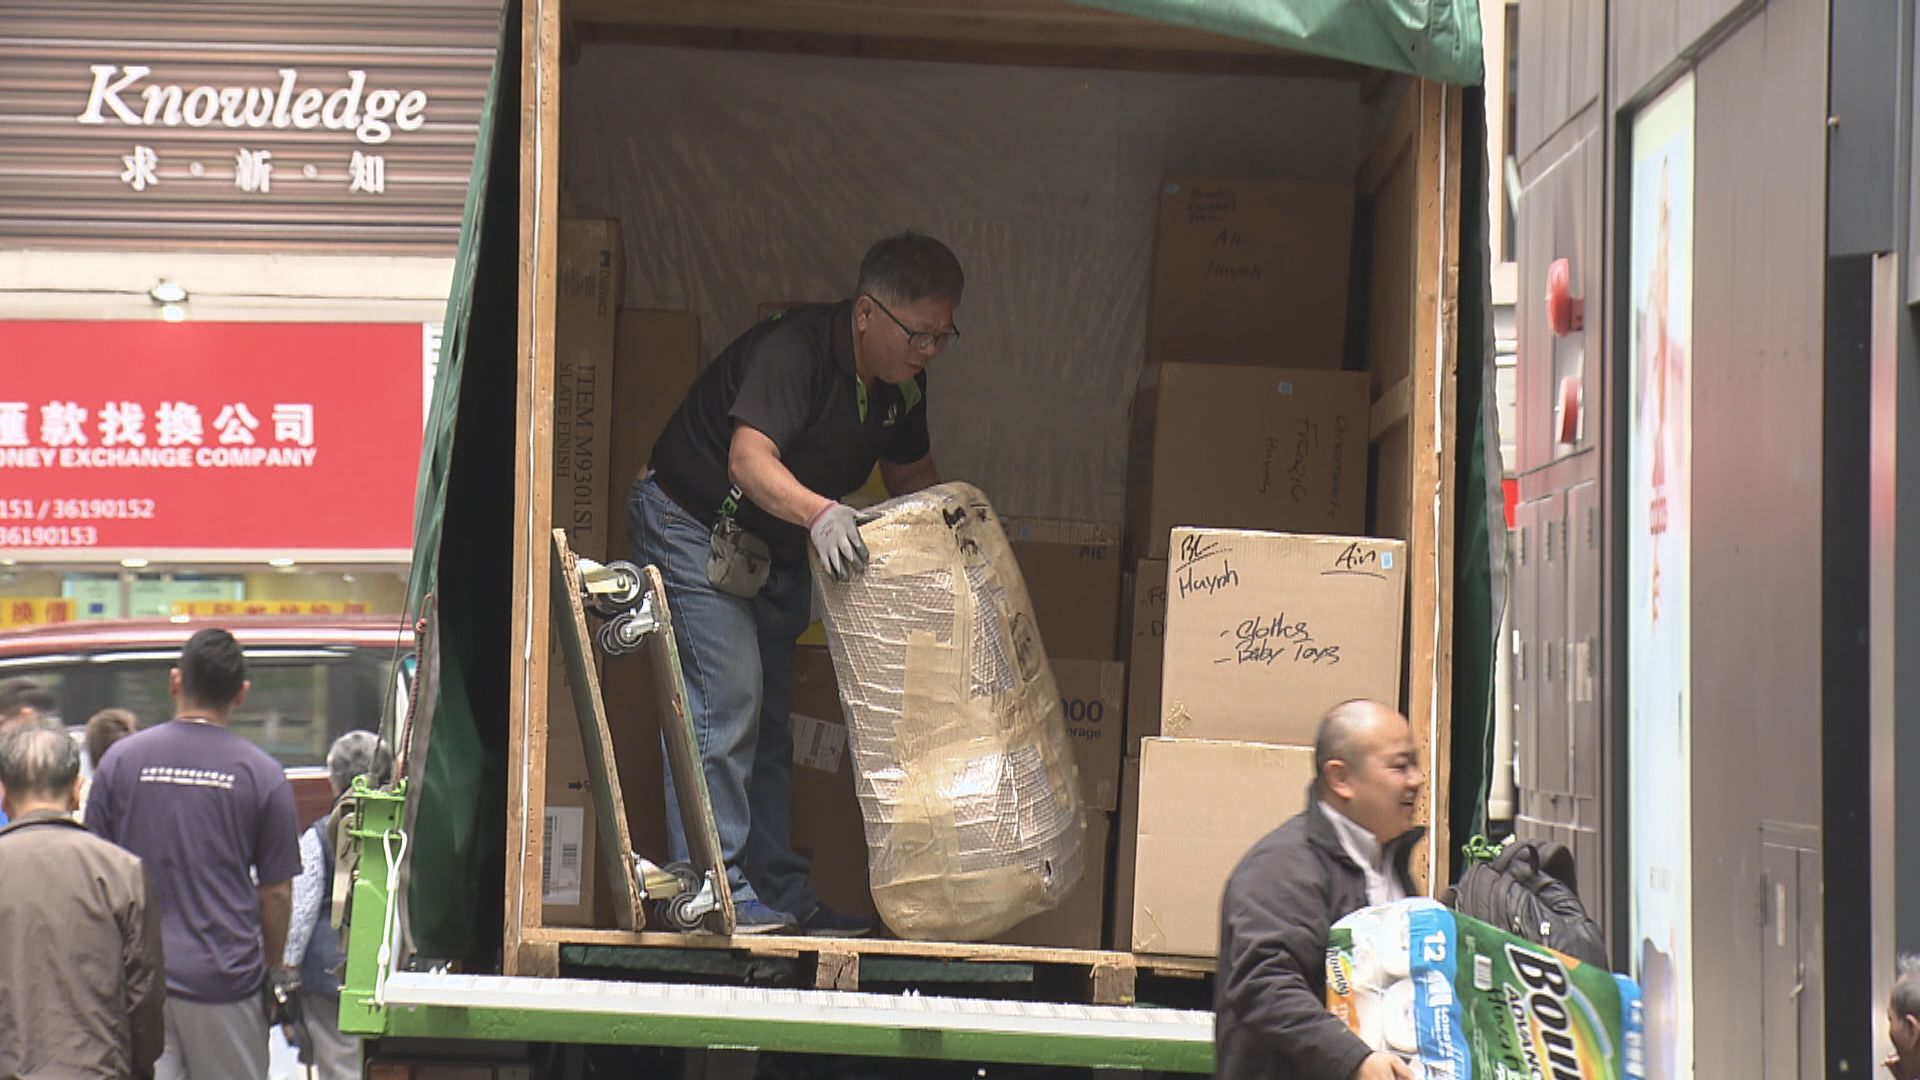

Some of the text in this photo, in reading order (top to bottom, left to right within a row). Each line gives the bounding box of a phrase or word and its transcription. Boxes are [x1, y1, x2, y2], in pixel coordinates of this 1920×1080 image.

[77, 65, 427, 143] Knowledge
[557, 363, 573, 478] SLATE FINISH
[60, 448, 193, 468] EXCHANGE
[196, 448, 316, 468] COMPANY
[574, 365, 595, 540] ITEM M9301SL
[52, 499, 155, 520] 36190152
[1423, 929, 1447, 962] 12
